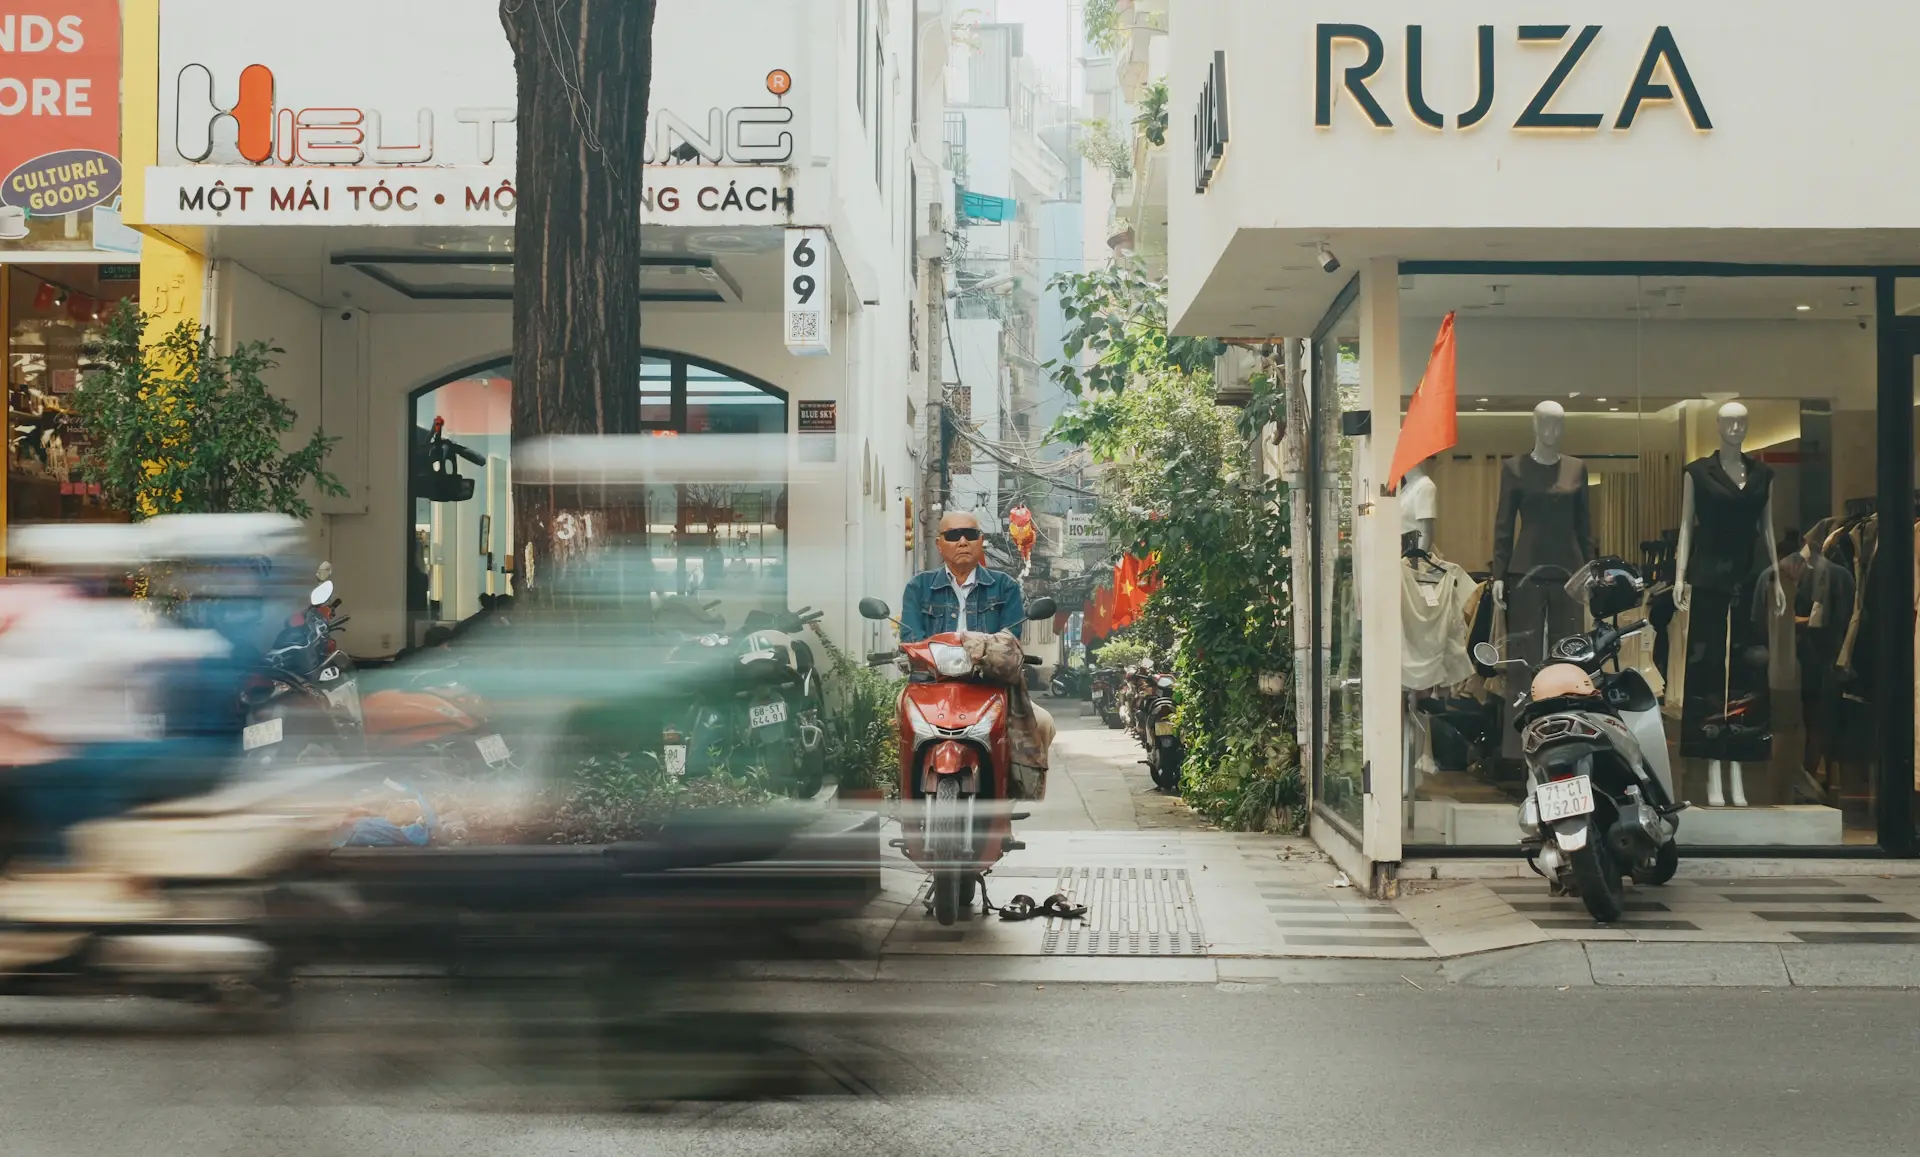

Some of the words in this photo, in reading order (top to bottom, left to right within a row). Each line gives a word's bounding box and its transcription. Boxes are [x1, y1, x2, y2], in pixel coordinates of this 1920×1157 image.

[1315, 22, 1713, 130] RUZA
[0, 77, 93, 116] ORE
[454, 106, 793, 164] TNG
[12, 158, 109, 192] CULTURAL
[29, 180, 99, 210] GOODS
[179, 179, 254, 217] MỘT
[270, 179, 330, 212] MÁI
[346, 179, 418, 212] TÓC
[465, 179, 518, 217] MỘ
[696, 179, 795, 213] CÁCH
[801, 410, 818, 418] BLUE
[820, 410, 833, 418] SKY
[556, 512, 593, 540] 31
